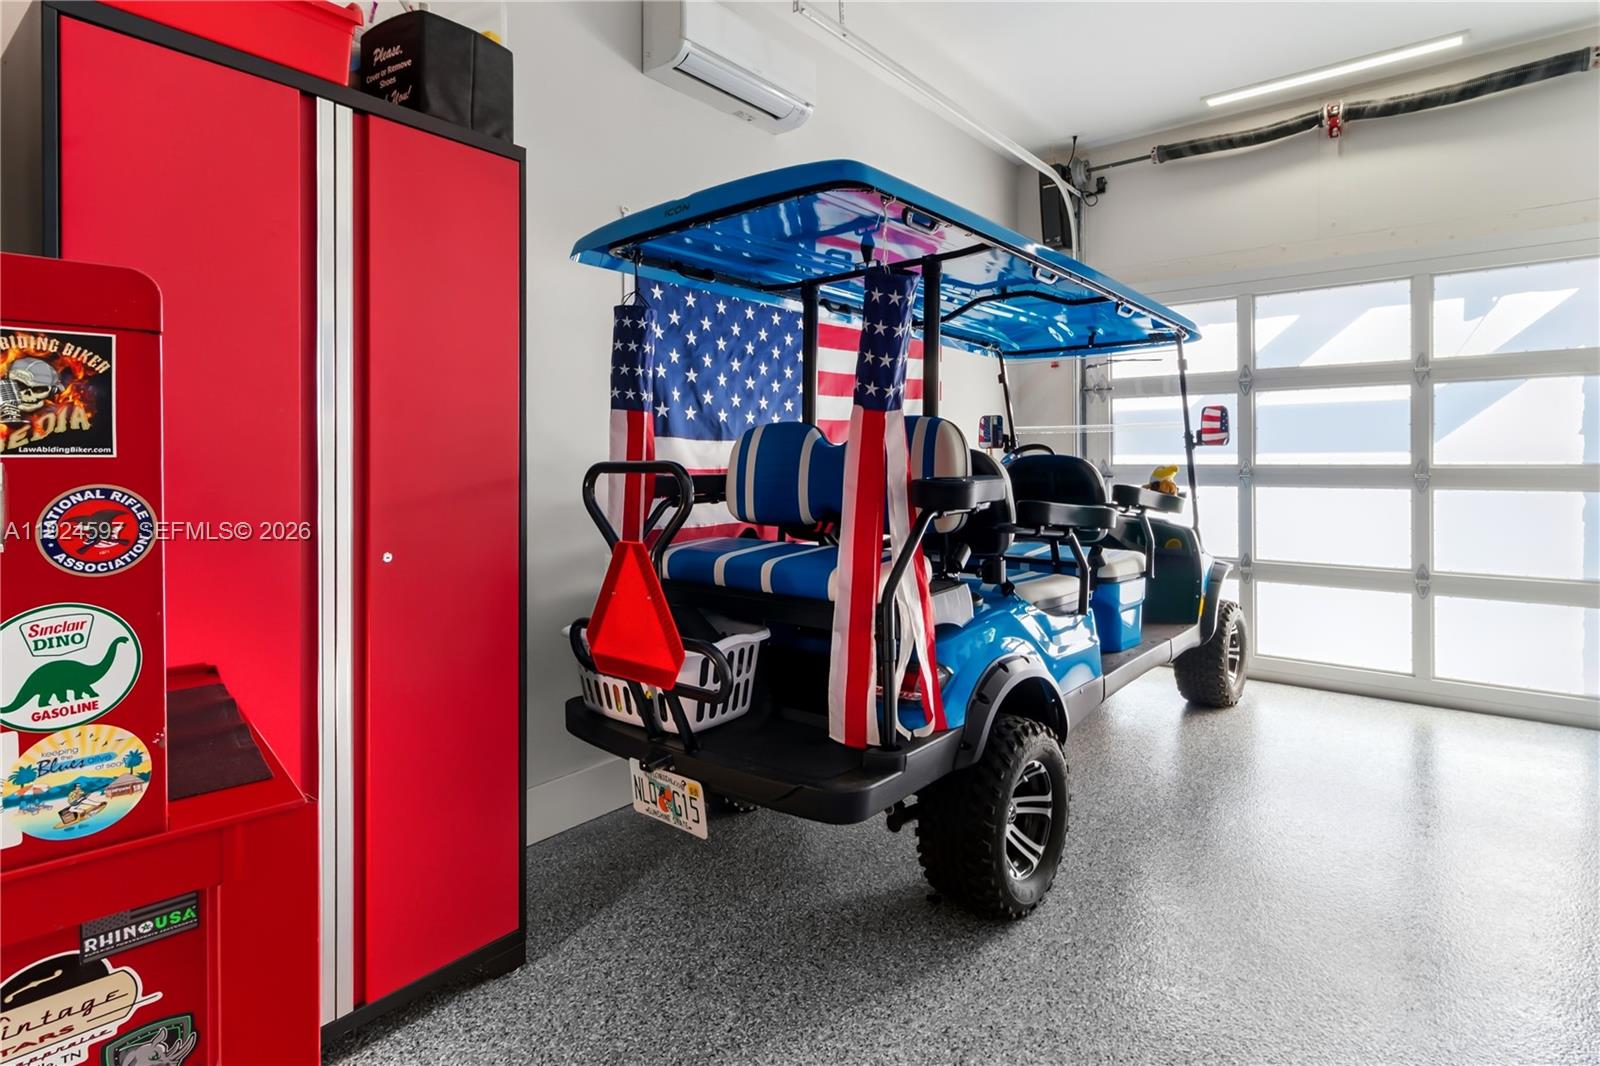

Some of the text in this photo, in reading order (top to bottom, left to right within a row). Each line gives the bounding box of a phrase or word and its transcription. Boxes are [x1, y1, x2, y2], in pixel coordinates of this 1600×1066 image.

[387, 59, 412, 74] Remove
[61, 342, 111, 374] BIKER
[18, 445, 112, 455] LawAbidingBiker.com
[43, 489, 149, 540] NATIONAL RIFLE
[53, 531, 151, 573] ASSOCIATION
[28, 619, 87, 639] Sinclair
[32, 632, 85, 652] DINO
[31, 699, 100, 723] GASOLINE
[36, 757, 86, 779] Blues
[61, 1049, 82, 1064] TN
